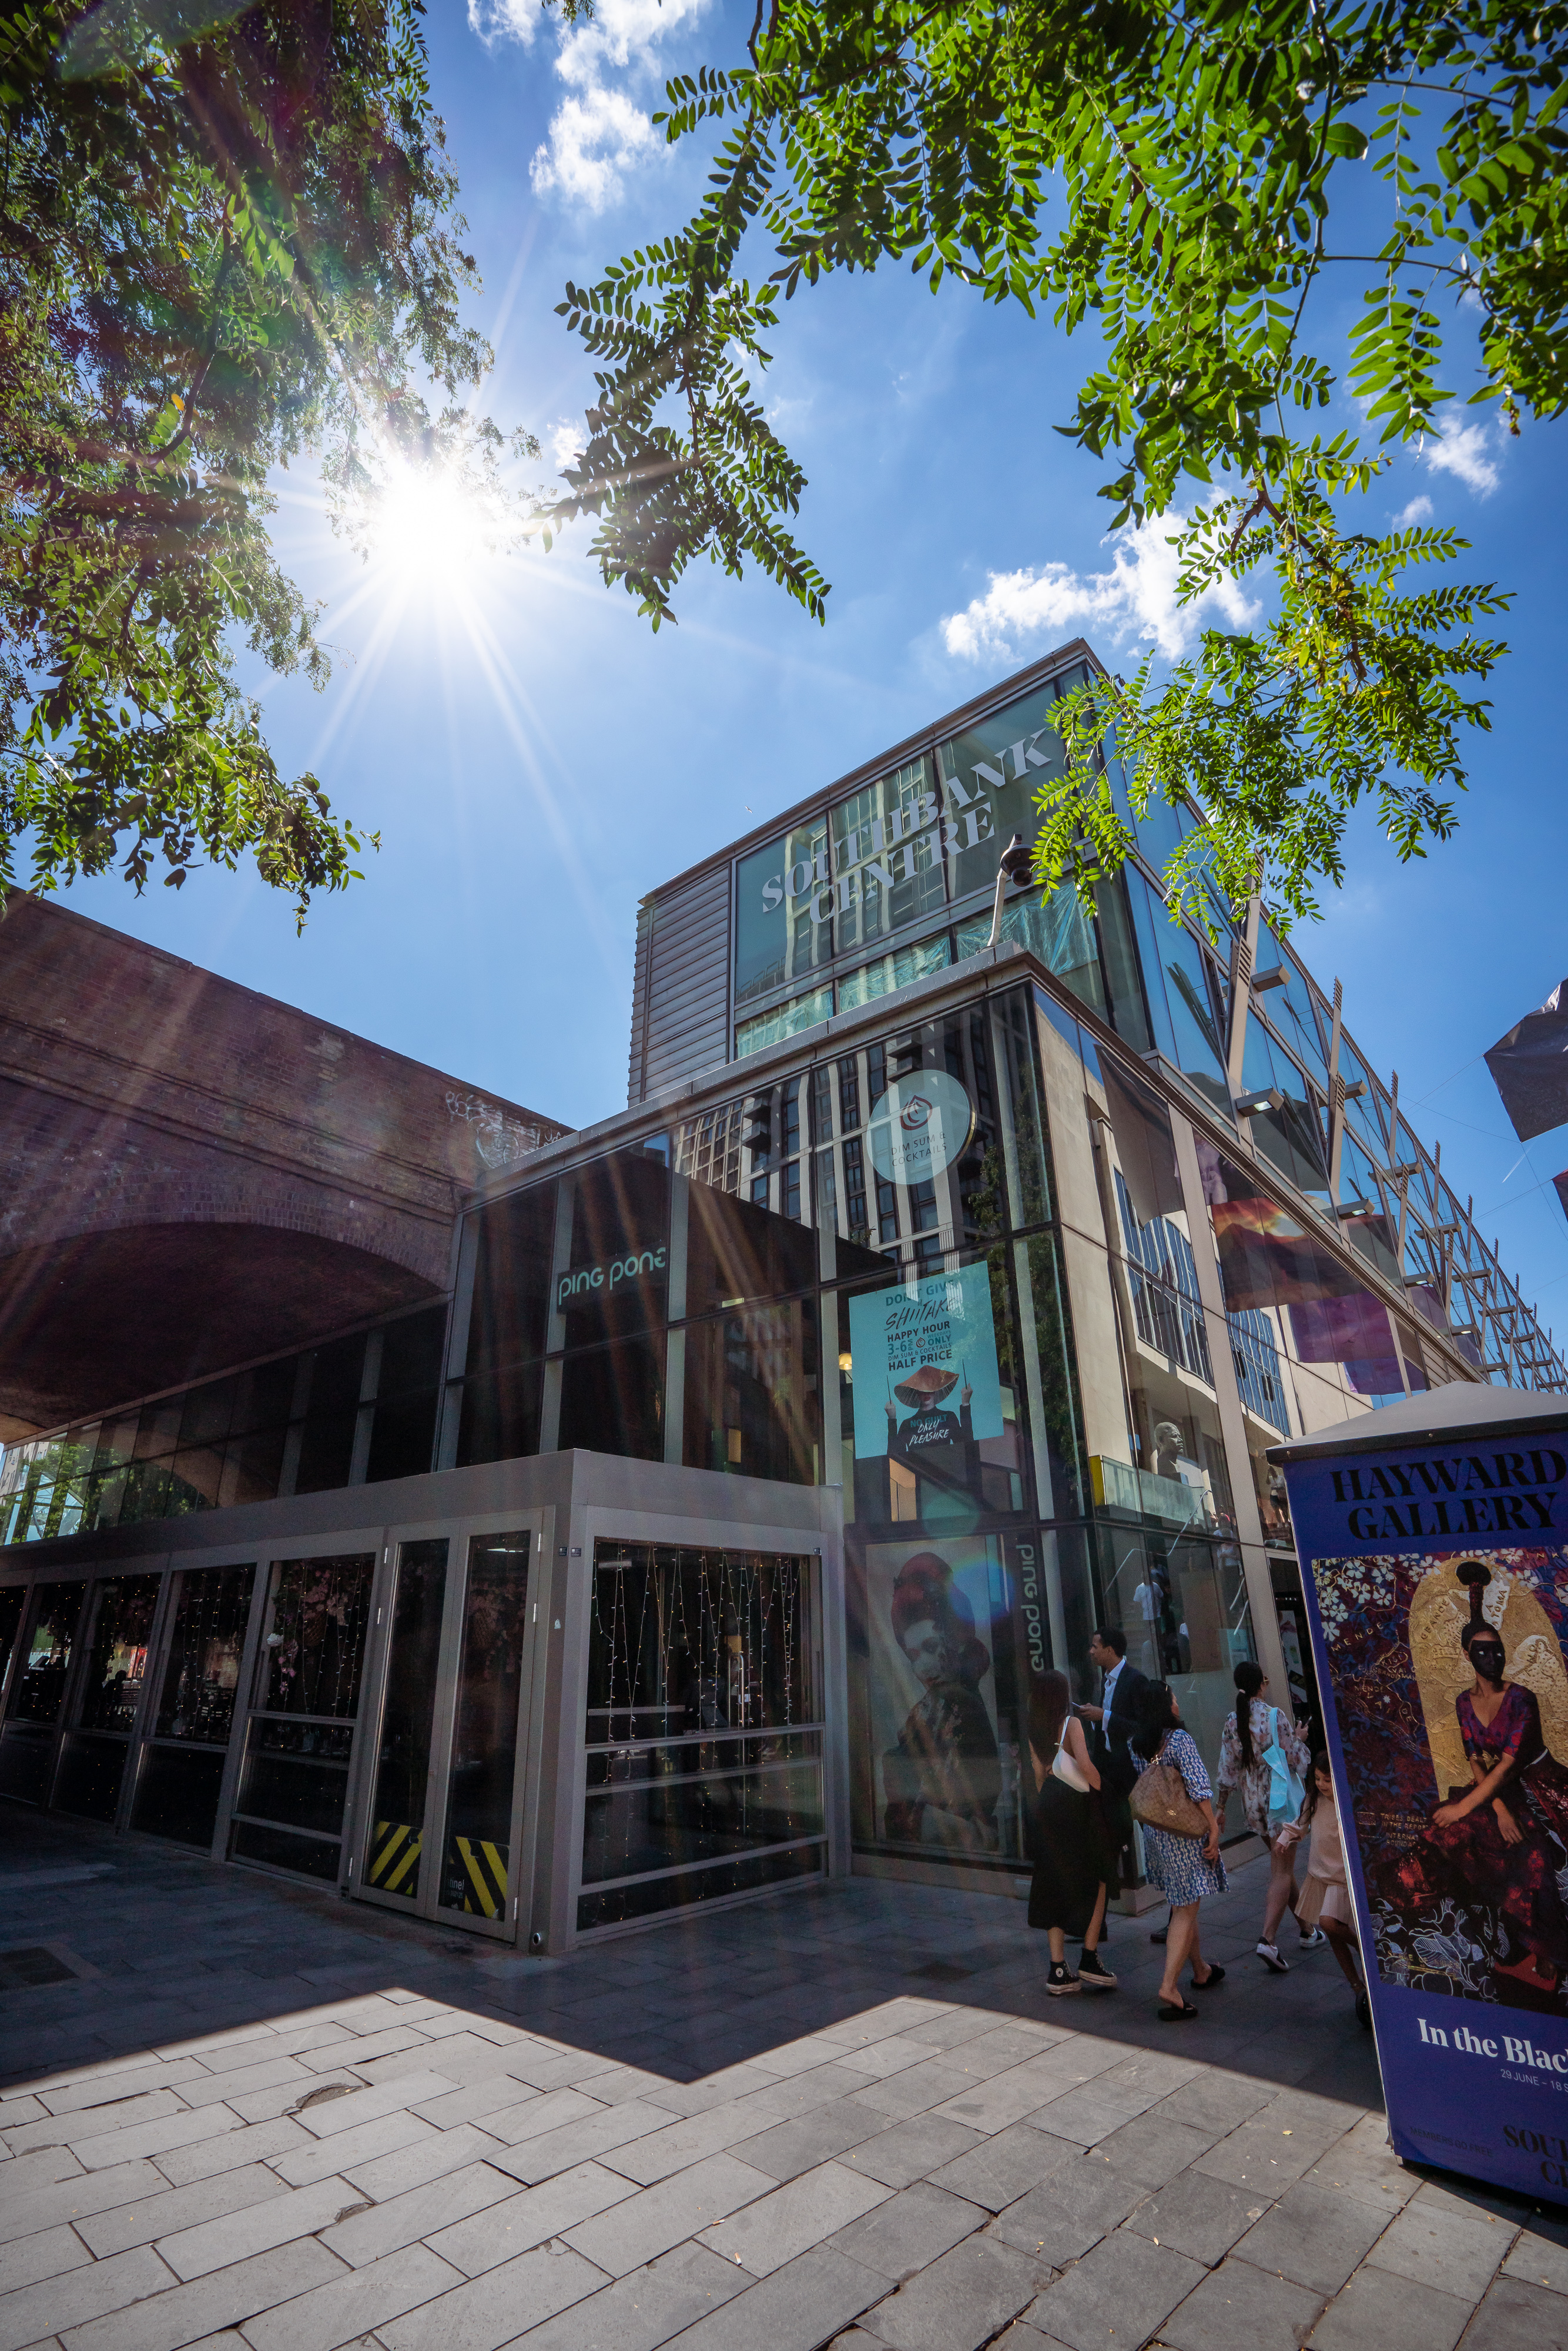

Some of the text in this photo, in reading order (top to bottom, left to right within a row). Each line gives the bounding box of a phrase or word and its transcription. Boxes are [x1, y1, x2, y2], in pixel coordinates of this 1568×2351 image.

[762, 728, 1052, 912] SOUTHBANK
[810, 802, 995, 924] CENTRE
[891, 1143, 910, 1156] DIM
[914, 1134, 935, 1148] SUM
[892, 1143, 947, 1167] COCKTAILS
[887, 1321, 950, 1342] HAPPY HOUR
[927, 1330, 951, 1338] WEEKDAYS
[888, 1334, 951, 1355] 3-6 PM ONLY
[889, 1349, 952, 1371] HALF PRICE
[910, 1414, 947, 1427] NO GUILT
[918, 1419, 940, 1433] ONLY
[909, 1429, 949, 1446] PLEASURE
[1329, 1449, 1568, 1502] HAYWARD
[1348, 1492, 1557, 1540] GALLERY
[1331, 1622, 1383, 1652] MENDE
[1381, 1813, 1403, 1821] TRIBES
[1417, 2018, 1568, 2073] In the Blac
[1500, 2069, 1512, 2079] 29
[1513, 2072, 1539, 2086] JUNE
[1550, 2081, 1562, 2091] 18
[1410, 2126, 1494, 2158] MEMBERS GO FREE
